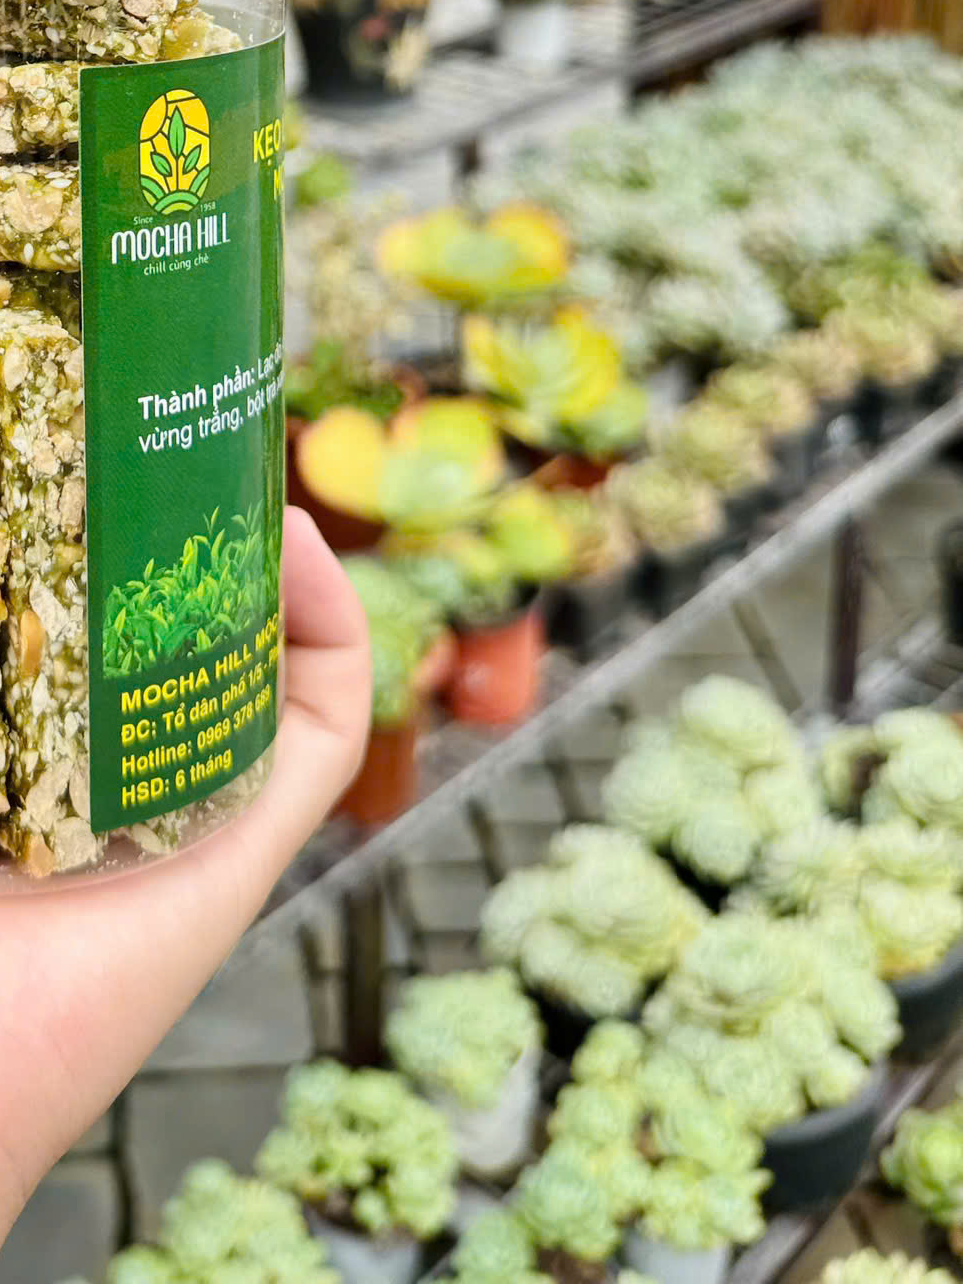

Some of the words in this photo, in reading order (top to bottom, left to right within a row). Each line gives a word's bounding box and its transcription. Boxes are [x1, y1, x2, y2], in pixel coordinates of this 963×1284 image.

[111, 221, 192, 265] MOCHA
[197, 212, 231, 250] HILL
[133, 216, 154, 226] Since
[143, 260, 166, 276] chill
[169, 259, 191, 271] cùng
[137, 384, 207, 421] Thành
[212, 365, 256, 406] phần:
[138, 424, 193, 453] vừng
[121, 667, 211, 714] MOCHA
[215, 643, 252, 679] HILL
[121, 719, 157, 747] ĐC:
[162, 702, 186, 732] Tổ
[189, 697, 218, 722] dân
[221, 671, 246, 711] phố
[121, 740, 192, 778] Hotline:
[197, 717, 230, 750] 0969
[233, 700, 254, 730] 378
[121, 777, 170, 808] HSD:
[175, 768, 186, 790] 6
[190, 748, 233, 785] tháng
